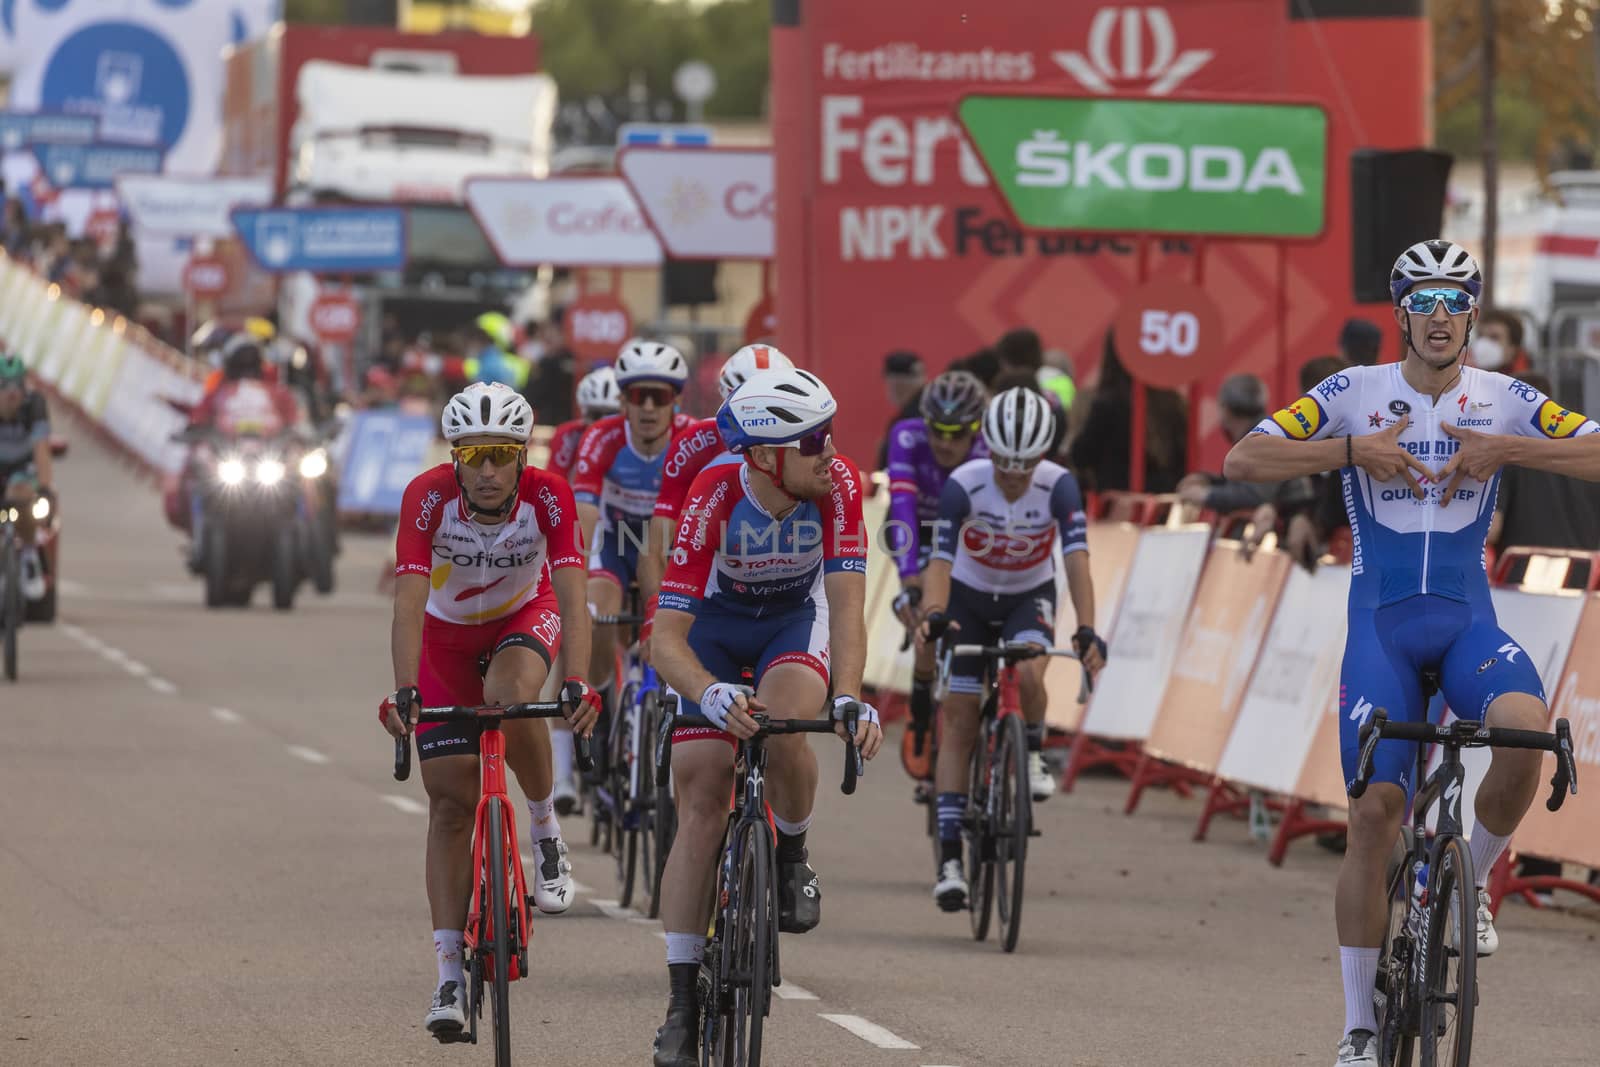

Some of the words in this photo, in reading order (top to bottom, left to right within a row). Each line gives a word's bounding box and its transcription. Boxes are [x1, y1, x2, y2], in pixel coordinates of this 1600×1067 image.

[822, 43, 1035, 81] Fertilizantes
[1015, 130, 1304, 196] ŠKODA
[840, 206, 946, 262] NPK
[1140, 310, 1199, 356] 50
[1320, 374, 1350, 402] PRO
[1508, 380, 1538, 402] PRO
[1457, 416, 1493, 427] latexco
[665, 429, 718, 478] Cofidis
[415, 489, 442, 532] Cofidis
[538, 486, 561, 528] Cofidis
[702, 480, 730, 519] energie
[677, 494, 703, 545] TOTAL
[432, 545, 538, 569] Cofidis
[746, 557, 797, 569] TOTAL
[422, 743, 435, 751] DE
[437, 737, 468, 747] ROSA
